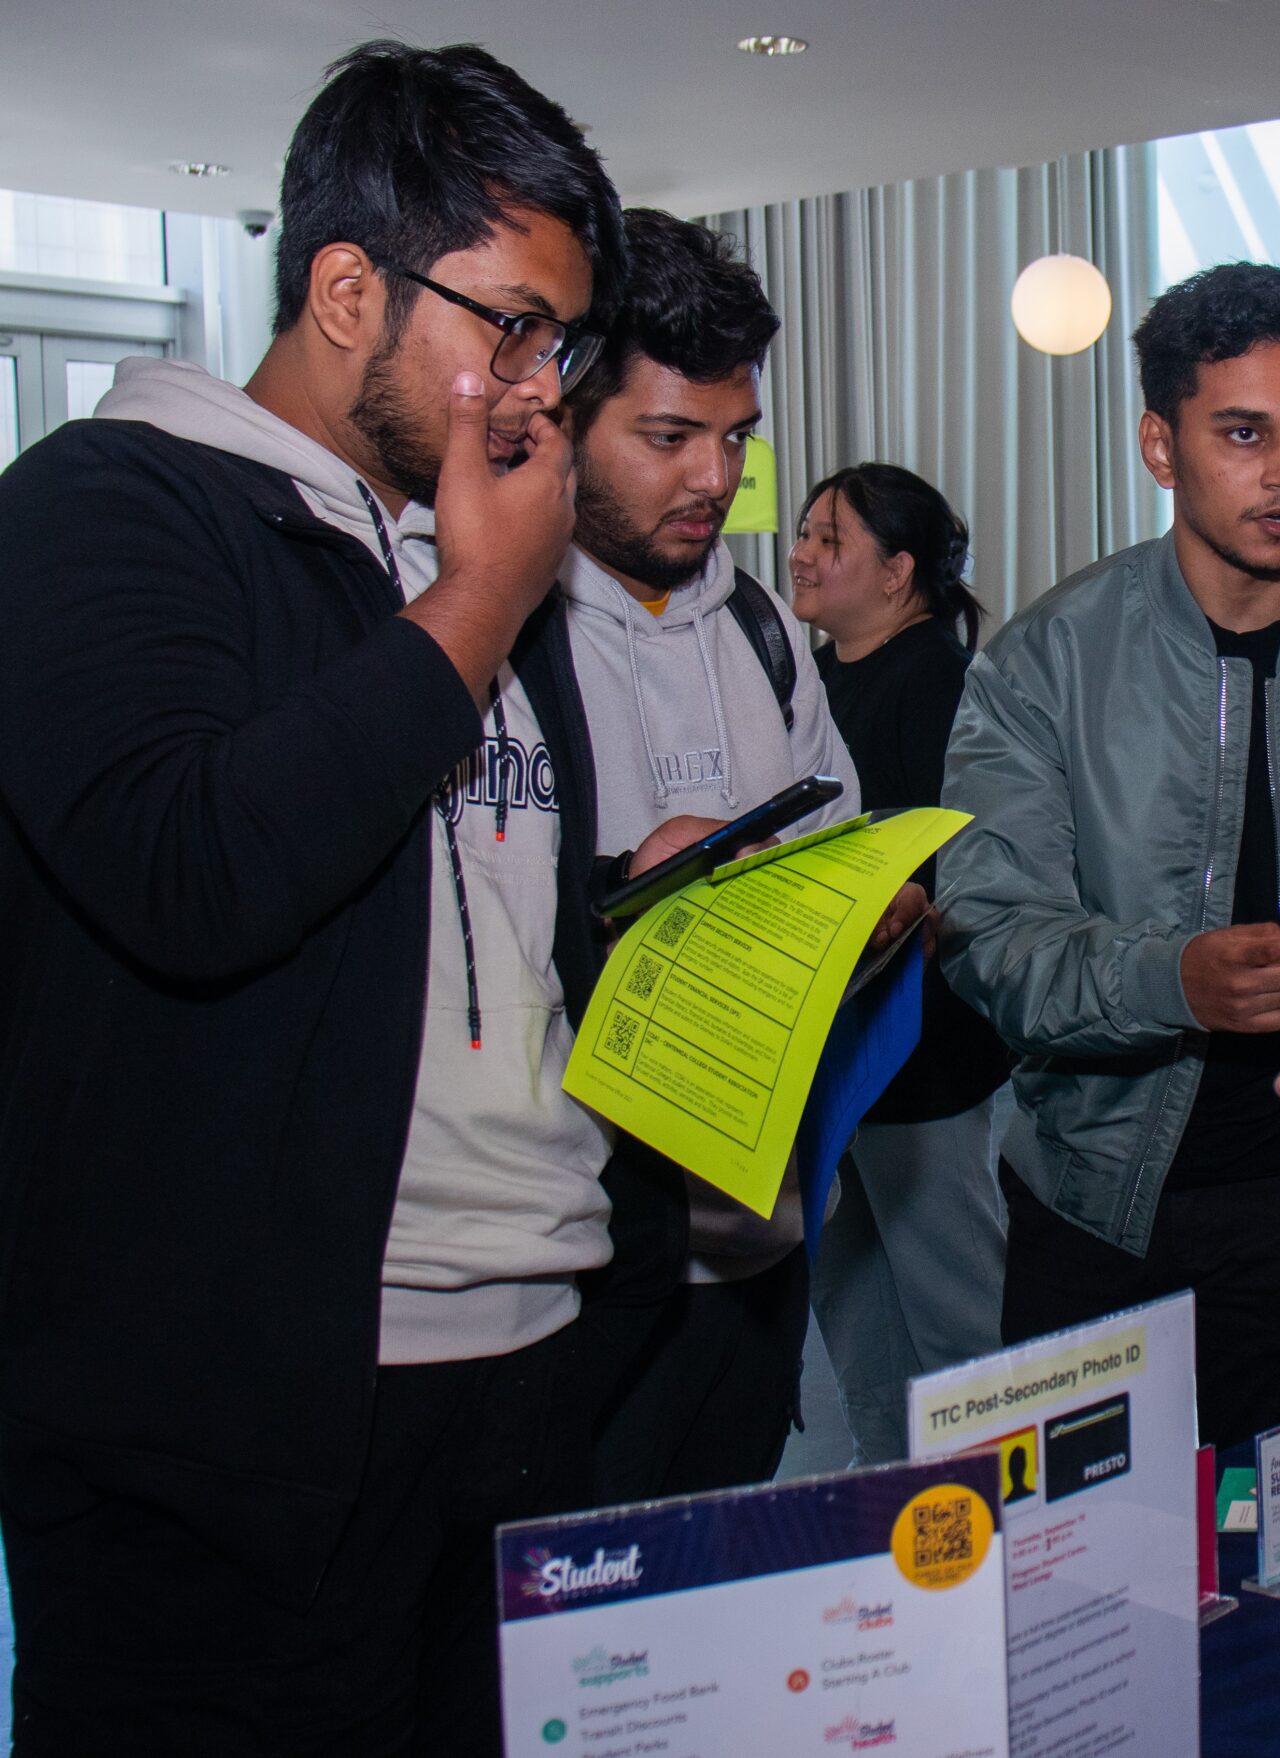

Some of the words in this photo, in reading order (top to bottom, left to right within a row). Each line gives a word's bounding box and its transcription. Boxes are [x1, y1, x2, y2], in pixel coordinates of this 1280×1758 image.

[930, 1404, 961, 1430] TTC
[965, 1369, 1078, 1418] Post-Secondary
[1083, 1354, 1122, 1379] Photo
[1126, 1344, 1140, 1363] ID
[1083, 1453, 1126, 1481] PRESTO
[538, 1543, 644, 1596] Student
[821, 1656, 855, 1672] Clubs
[822, 1672, 869, 1690] Starting
[872, 1669, 881, 1679] A
[883, 1662, 912, 1678] Club
[578, 1698, 650, 1720] Emergency
[653, 1689, 687, 1704] Food
[689, 1680, 720, 1698] Bank
[581, 1724, 624, 1741] Transit
[626, 1712, 688, 1735] Discounts
